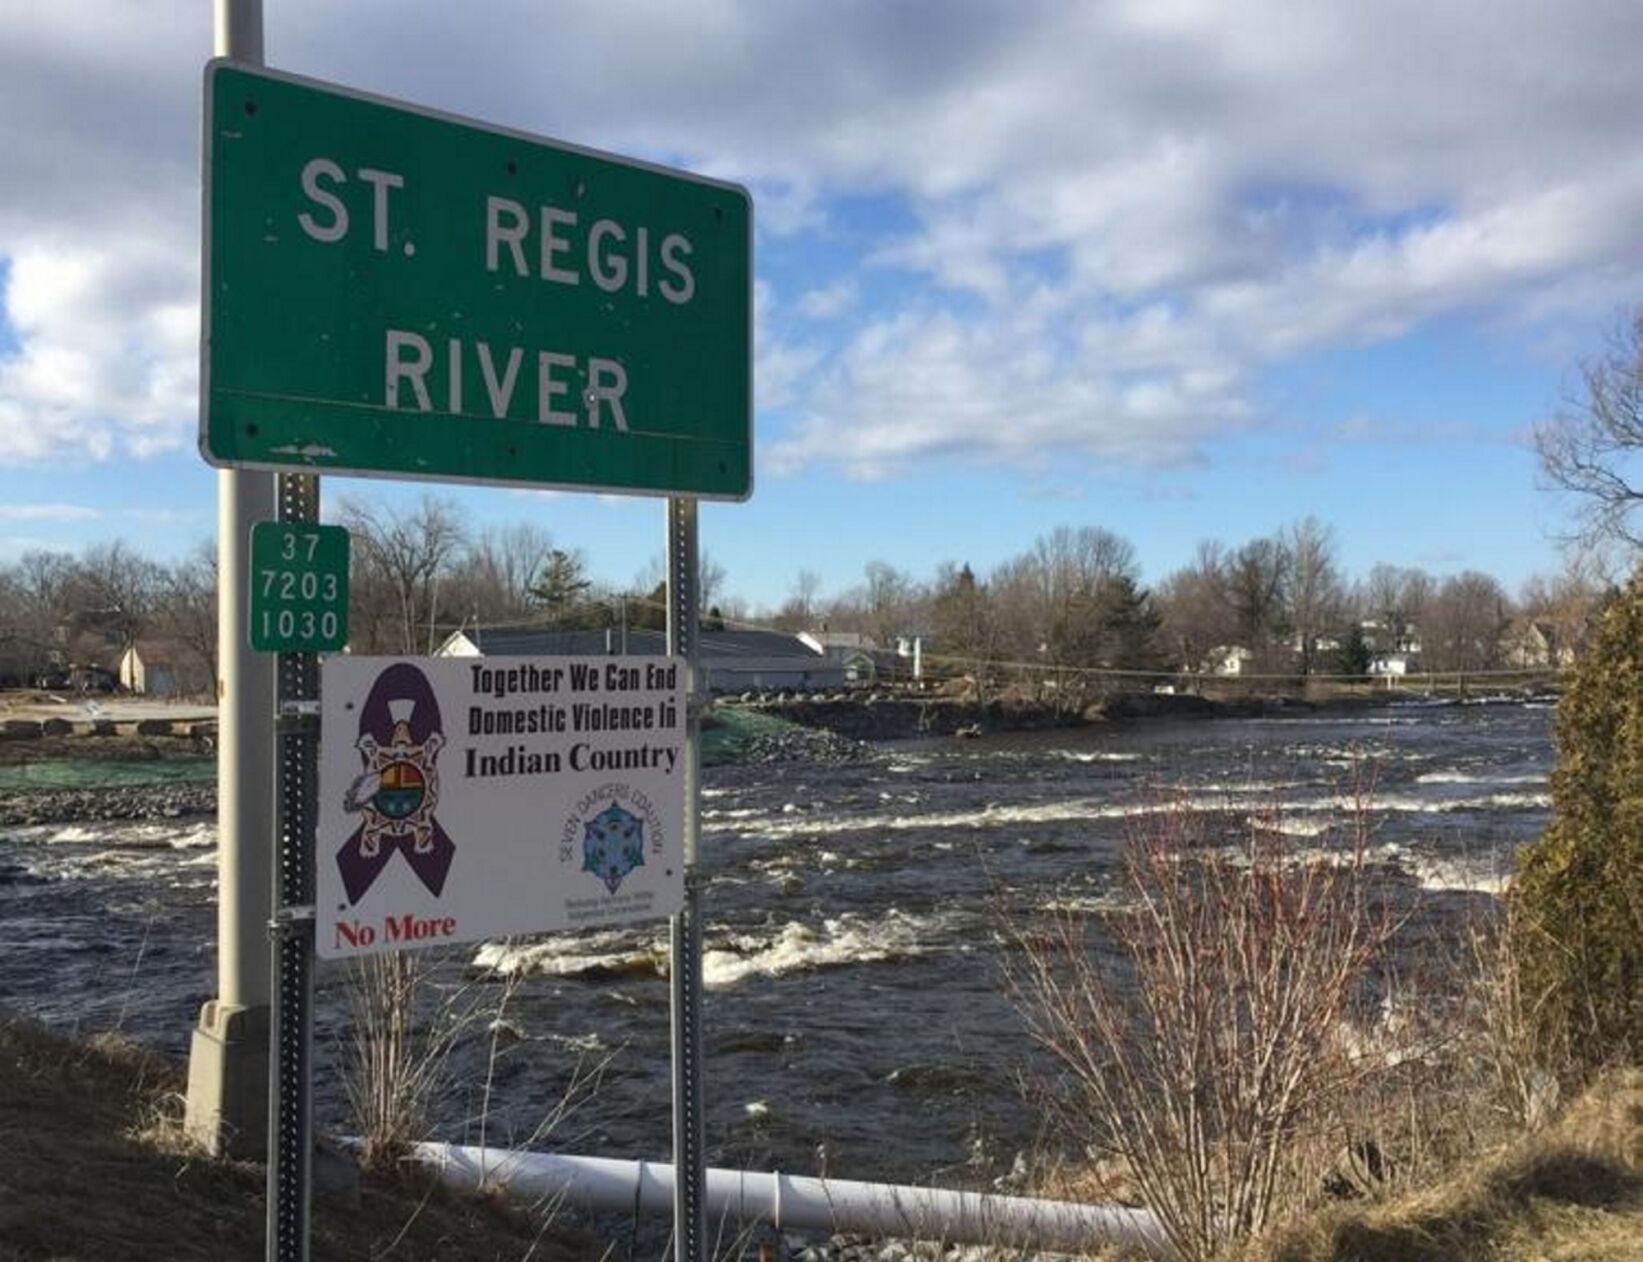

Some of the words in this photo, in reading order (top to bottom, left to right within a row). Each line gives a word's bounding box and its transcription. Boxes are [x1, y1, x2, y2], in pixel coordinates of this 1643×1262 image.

[298, 158, 415, 257] ST.
[486, 196, 696, 304] REGIS
[385, 329, 629, 432] RIVER
[281, 533, 320, 562] 37
[261, 570, 338, 602] 7203
[262, 610, 338, 639] 1030
[471, 664, 563, 698] Together
[569, 665, 599, 692] We
[605, 664, 640, 691] Can
[646, 663, 676, 690] End
[469, 704, 566, 735] Domestic
[572, 702, 654, 732] Violence
[658, 703, 676, 729] In
[465, 746, 561, 778] Indian
[569, 742, 680, 774] Country
[560, 814, 581, 863] SEVEN
[334, 920, 375, 949] No
[384, 912, 456, 942] More
